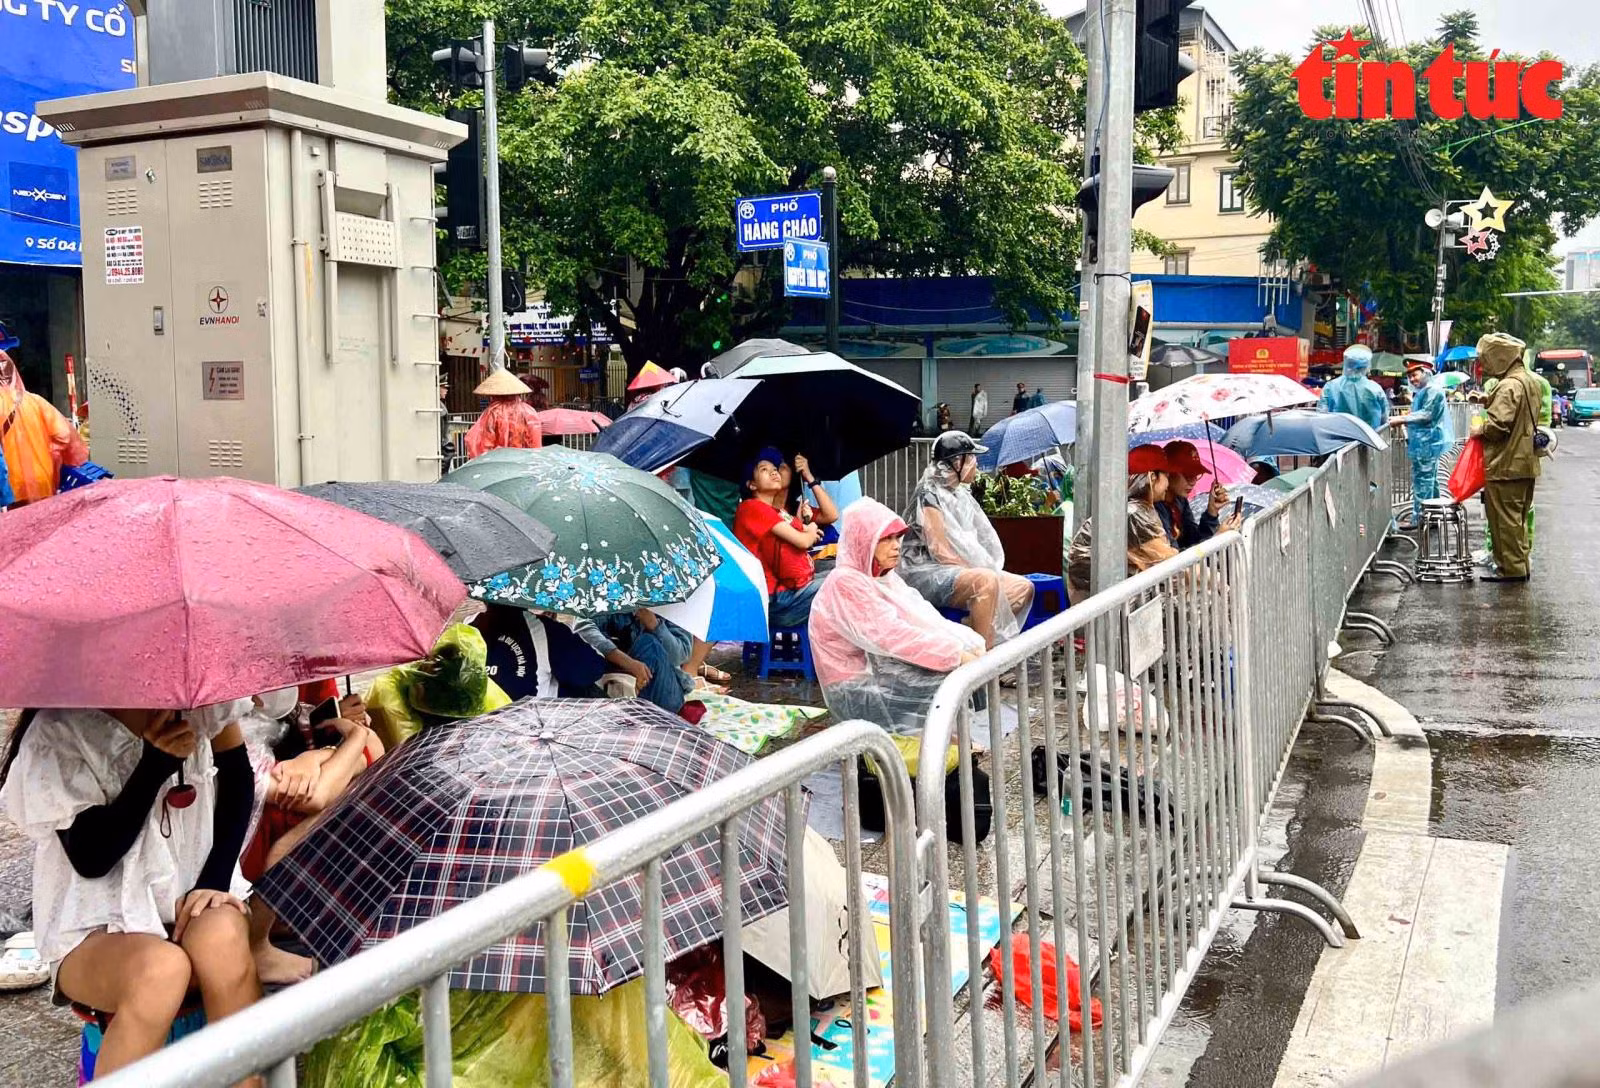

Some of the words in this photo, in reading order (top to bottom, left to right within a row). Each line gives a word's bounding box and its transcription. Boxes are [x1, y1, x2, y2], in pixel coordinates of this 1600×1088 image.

[34, 0, 79, 26] TY
[86, 3, 126, 37] CỔ
[771, 197, 799, 213] PHỐ
[743, 218, 780, 242] HÀNG
[783, 214, 817, 237] CHÁO
[37, 237, 57, 250] Số
[58, 240, 77, 252] 04
[199, 316, 240, 325] EVNHANOI
